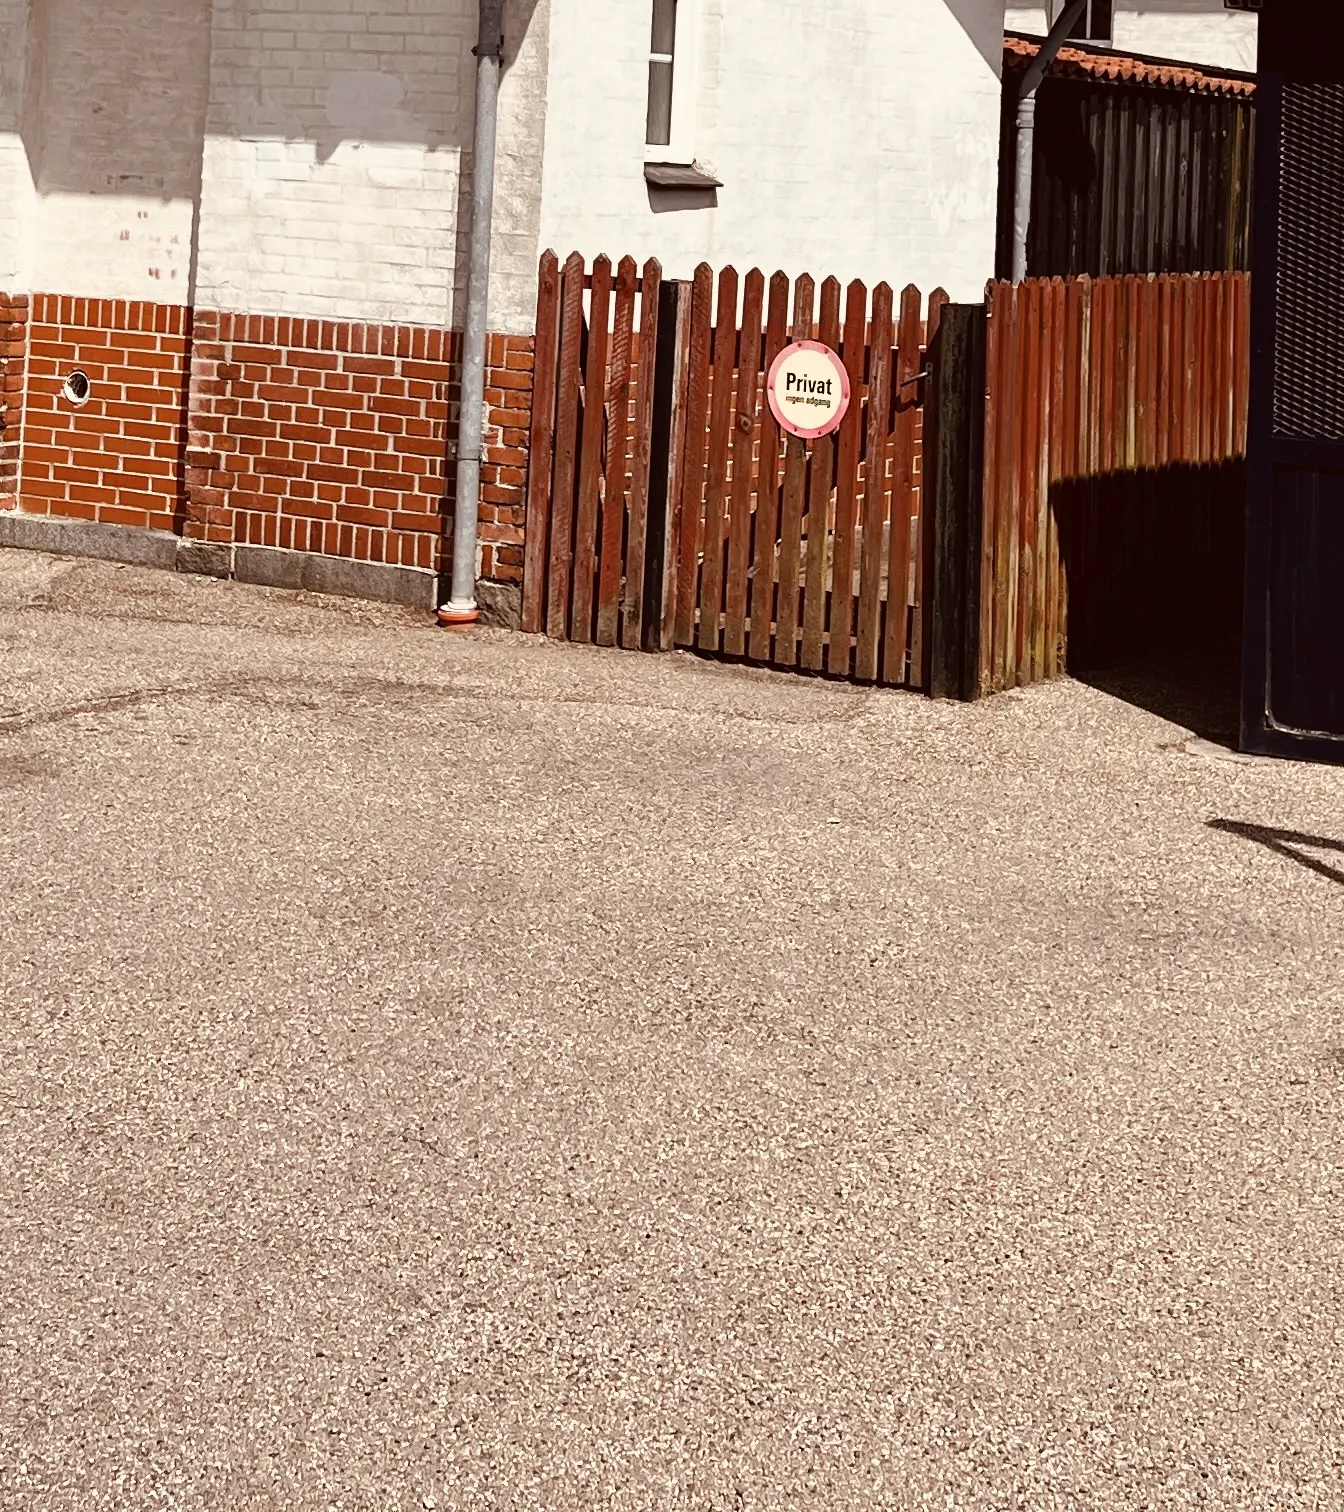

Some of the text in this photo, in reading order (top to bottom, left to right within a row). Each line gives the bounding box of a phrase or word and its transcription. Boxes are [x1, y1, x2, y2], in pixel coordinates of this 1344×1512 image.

[786, 372, 832, 395] Privat
[785, 395, 831, 409] ingen adgang
